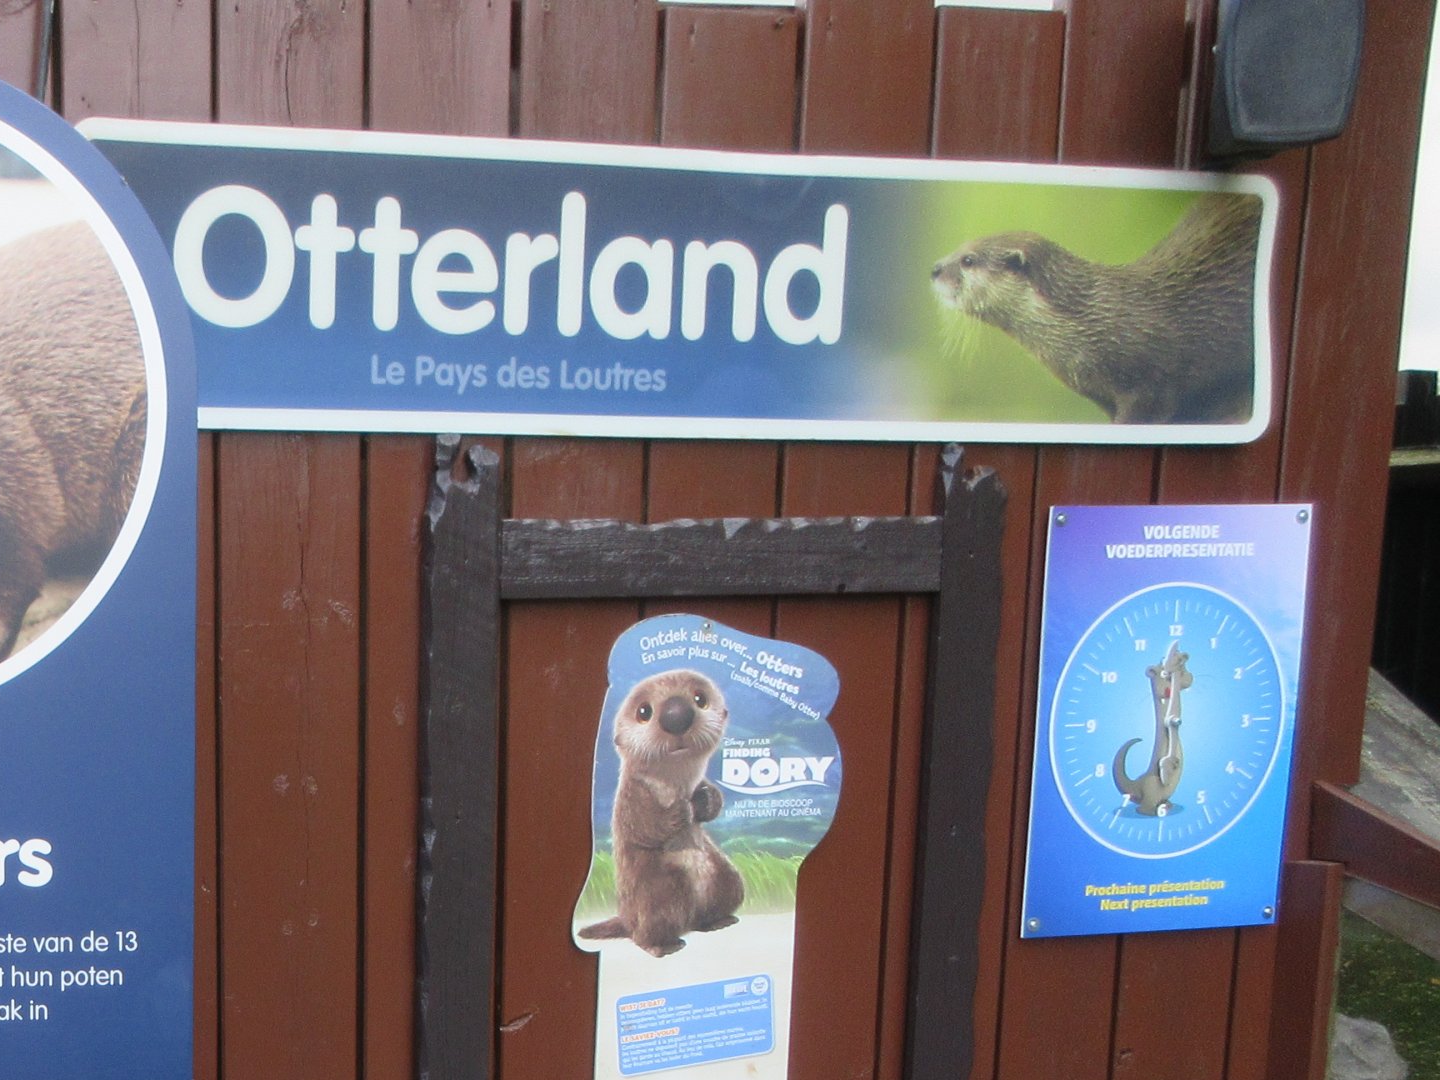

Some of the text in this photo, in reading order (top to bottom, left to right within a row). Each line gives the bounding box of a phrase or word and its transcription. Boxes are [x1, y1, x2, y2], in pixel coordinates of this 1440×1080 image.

[173, 184, 849, 345] Otterland
[370, 353, 667, 395] Le Pays des Loutres
[1143, 524, 1220, 540] VOLGENDE
[1106, 542, 1255, 559] VOEDERPRESENTATIE
[1169, 624, 1184, 637] 12
[1134, 639, 1146, 651] 11
[1210, 637, 1217, 649] 1
[640, 628, 687, 650] Ontdek
[756, 651, 804, 678] Otters
[641, 646, 799, 694] En savoir plus sur Les loutres
[1101, 671, 1118, 684] 10
[1233, 668, 1243, 680] 2
[1086, 719, 1097, 734] 9
[1241, 714, 1250, 728] 3
[748, 738, 770, 746] PIXAR
[723, 747, 771, 758] FINDING
[721, 756, 835, 787] DORY
[1094, 763, 1105, 777] 8
[1225, 760, 1235, 774] 4
[1122, 793, 1131, 808] 7
[1196, 790, 1206, 804] 5
[1157, 803, 1167, 818] 6
[1085, 878, 1225, 896] Prochaine présentation
[1100, 894, 1208, 911] Next presentation
[32, 936, 73, 953] van
[80, 930, 109, 953] de
[115, 930, 138, 952] 13
[11, 964, 53, 987] hun
[60, 965, 123, 992] poten
[29, 999, 48, 1021] in
